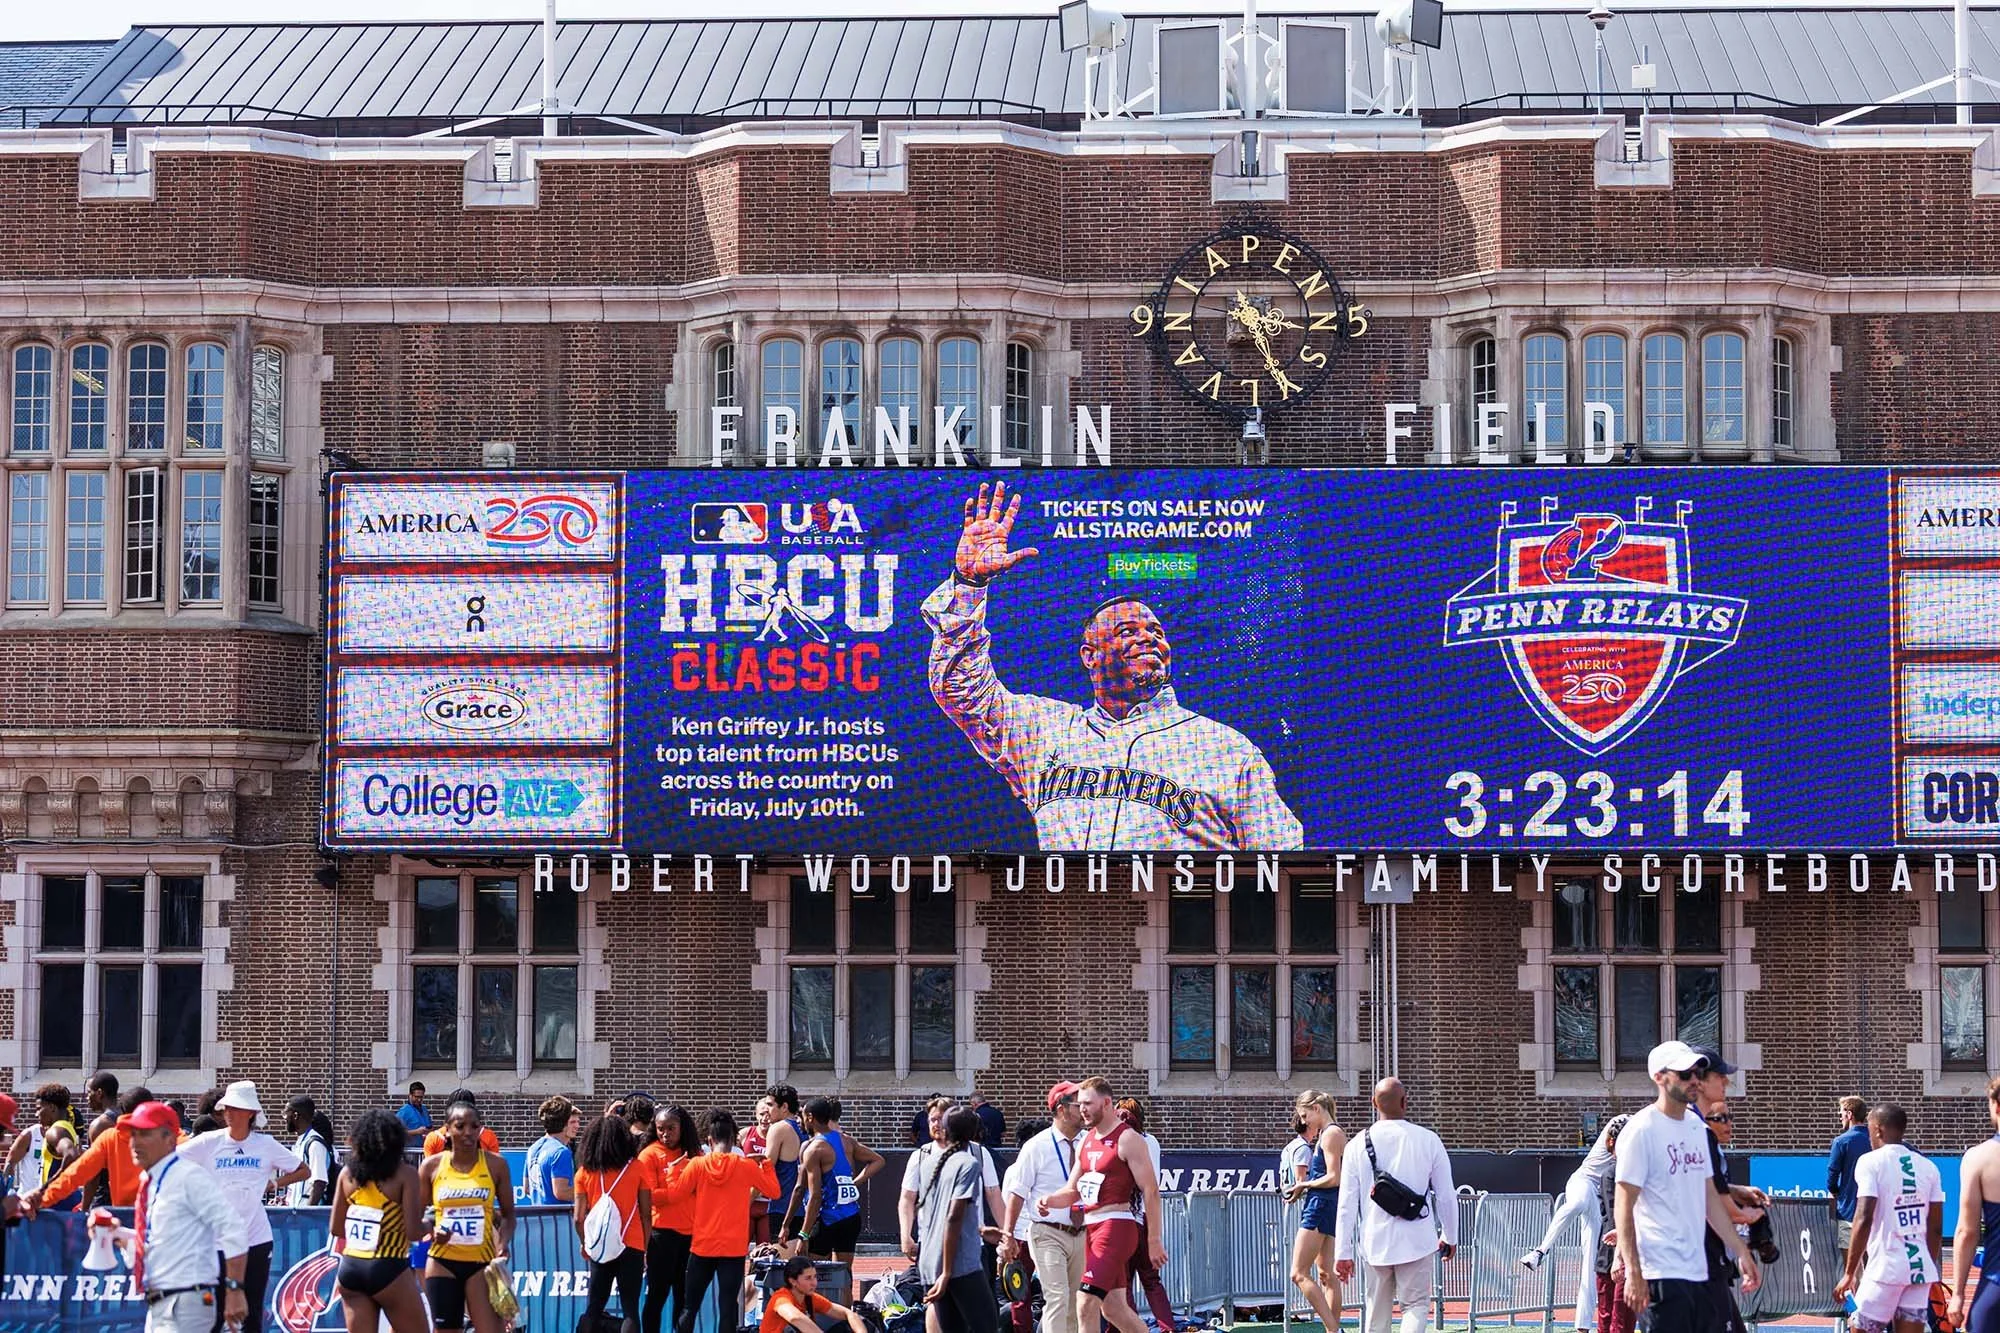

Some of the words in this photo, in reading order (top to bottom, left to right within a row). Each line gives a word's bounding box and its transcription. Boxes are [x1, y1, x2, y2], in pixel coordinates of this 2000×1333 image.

[1133, 304, 1153, 337] 9
[1348, 304, 1368, 337] 5
[711, 405, 1112, 467] FRANKLIN
[1384, 403, 1615, 465] FIELD
[1040, 500, 1124, 517] TICKETS
[1127, 500, 1159, 517] ON
[1161, 500, 1212, 518] SALE
[1214, 500, 1265, 517] NOW
[357, 513, 480, 533] AMERICA
[486, 494, 598, 549] 250
[1053, 521, 1252, 538] ALLSTARGAME.COM
[781, 535, 864, 545] BASEBALL
[1115, 559, 1140, 573] Buy
[1142, 559, 1191, 572] Tickets
[660, 554, 899, 632] HBCU
[1456, 600, 1570, 635] PENN
[1577, 598, 1736, 632] RELAYS
[672, 642, 881, 692] CLASSIC
[1561, 659, 1624, 670] AMERICA
[1562, 672, 1627, 704] 250
[435, 700, 512, 719] Grace
[671, 716, 713, 736] Ken
[717, 716, 791, 739] Griffey
[795, 716, 819, 736] Jr.
[823, 716, 886, 736] hosts
[655, 744, 693, 766] top
[697, 743, 762, 762] talent
[766, 743, 818, 762] from
[822, 743, 899, 763] HBCUs
[660, 774, 733, 790] across
[737, 771, 774, 790] the
[778, 773, 862, 793] country
[866, 774, 894, 790] on
[363, 774, 498, 826] College
[510, 783, 563, 813] AVE
[1034, 765, 1197, 827] MARINERS
[1443, 769, 1751, 838] 3:23:14
[1924, 772, 2000, 824] COR
[689, 798, 760, 820] Friday,
[763, 798, 807, 820] July
[810, 798, 865, 817] 10th.
[534, 853, 754, 893] ROBERT
[803, 853, 954, 893] WOOD
[1006, 853, 1279, 893] JOHNSON
[1336, 853, 1552, 893] FAMILY
[1602, 853, 1998, 893] SCOREBOARD
[215, 1157, 261, 1168] DELAWARE
[841, 1187, 857, 1199] BB
[451, 1220, 477, 1237] AE
[1898, 1209, 1920, 1227] BH
[349, 1223, 373, 1241] AE
